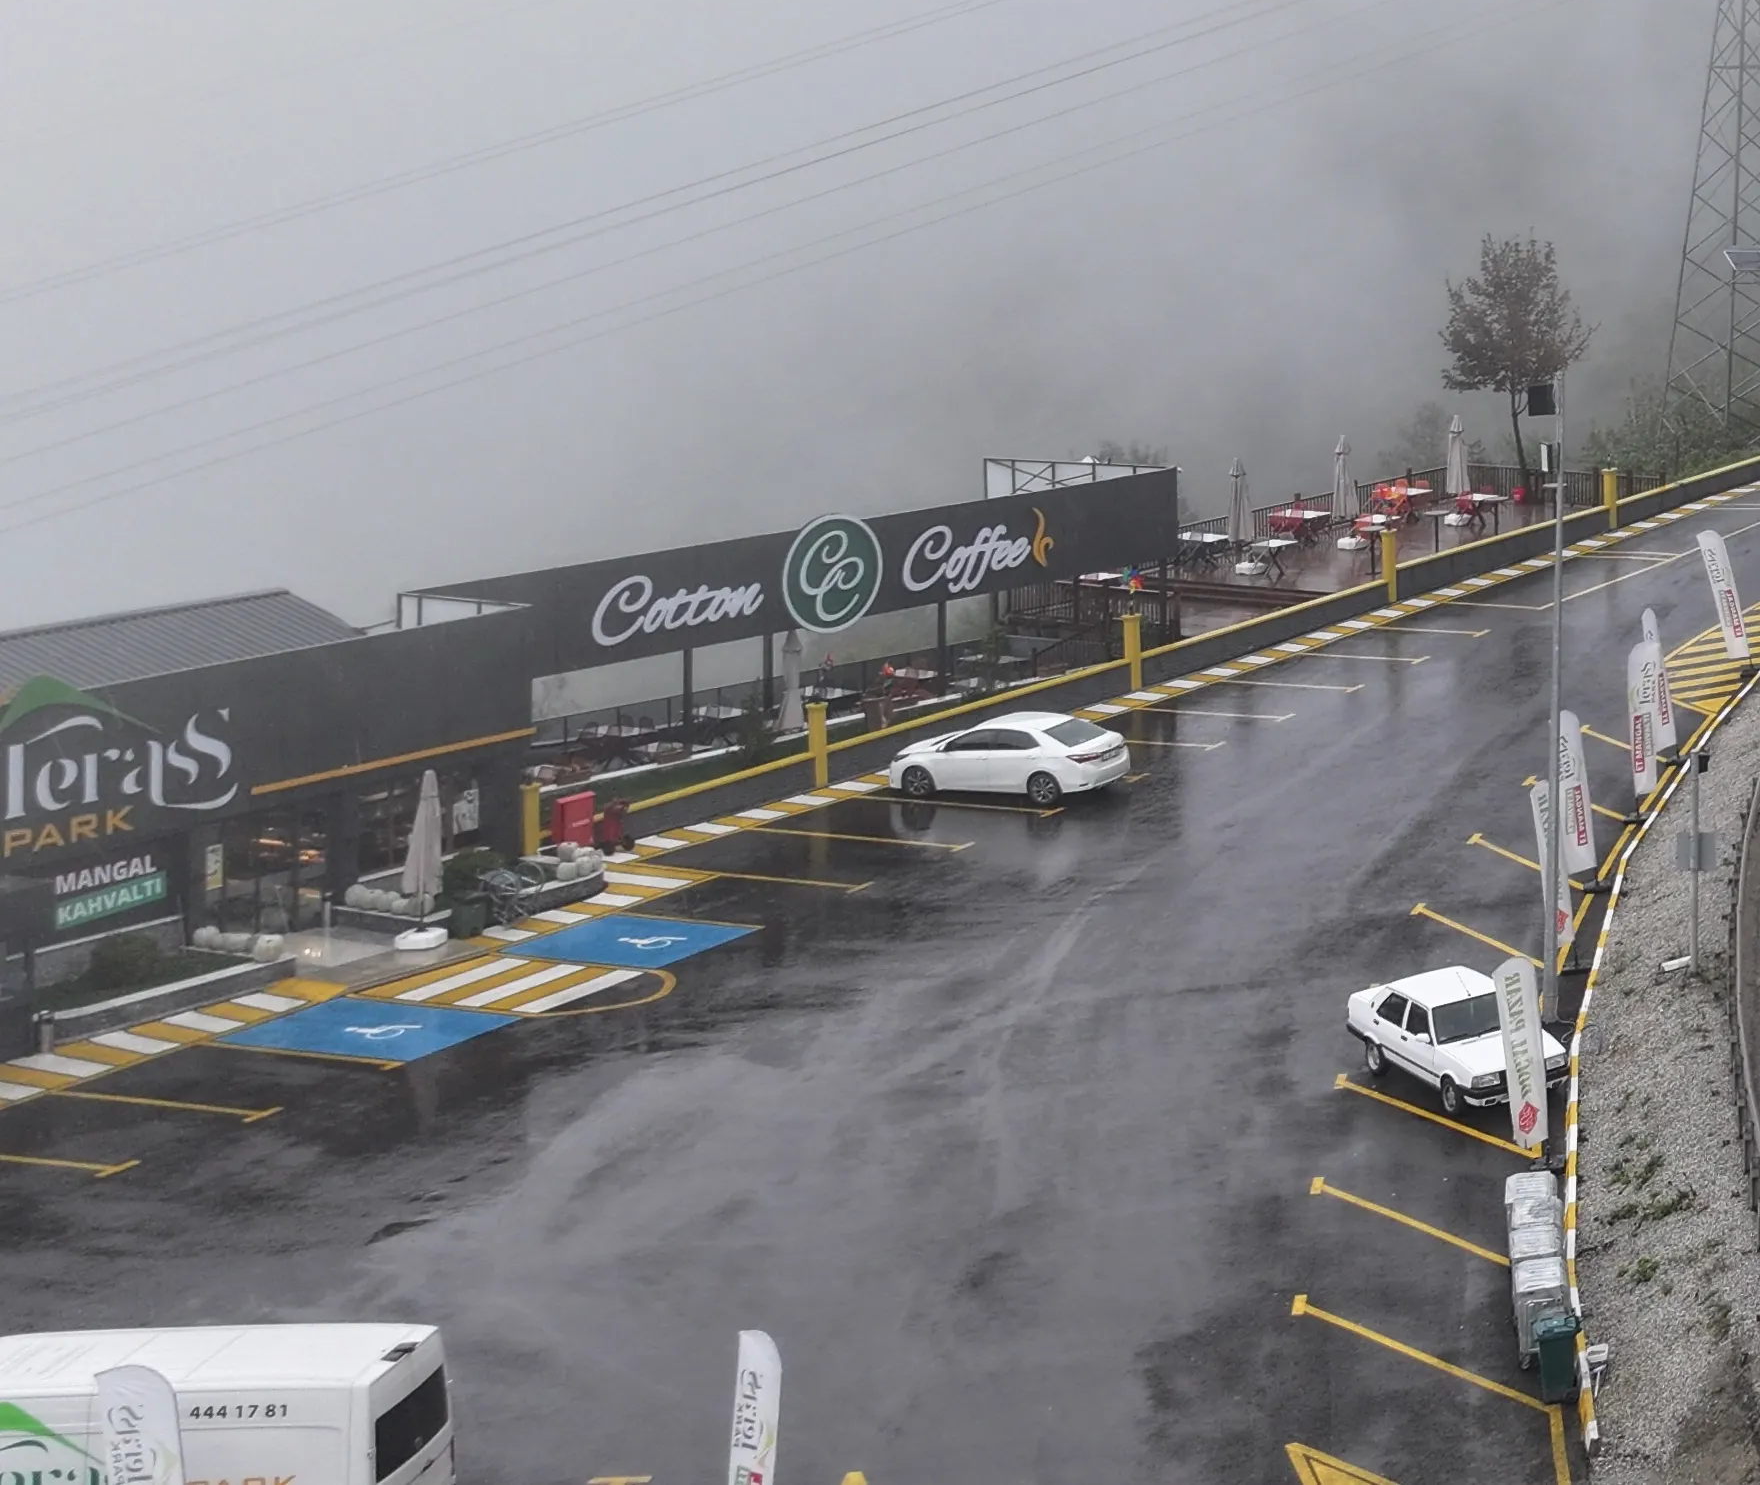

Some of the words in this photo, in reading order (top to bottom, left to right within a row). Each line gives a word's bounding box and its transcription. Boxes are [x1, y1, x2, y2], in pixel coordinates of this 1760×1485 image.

[592, 575, 764, 647] Cotton
[902, 525, 1031, 593] Coffee
[1634, 717, 1643, 759] MANGAL
[4, 804, 135, 858] PARK
[55, 854, 158, 895] MANGAL
[56, 877, 163, 925] KAHVALTI
[189, 1405, 228, 1420] 444
[234, 1404, 259, 1419] 17
[264, 1404, 288, 1419] 81
